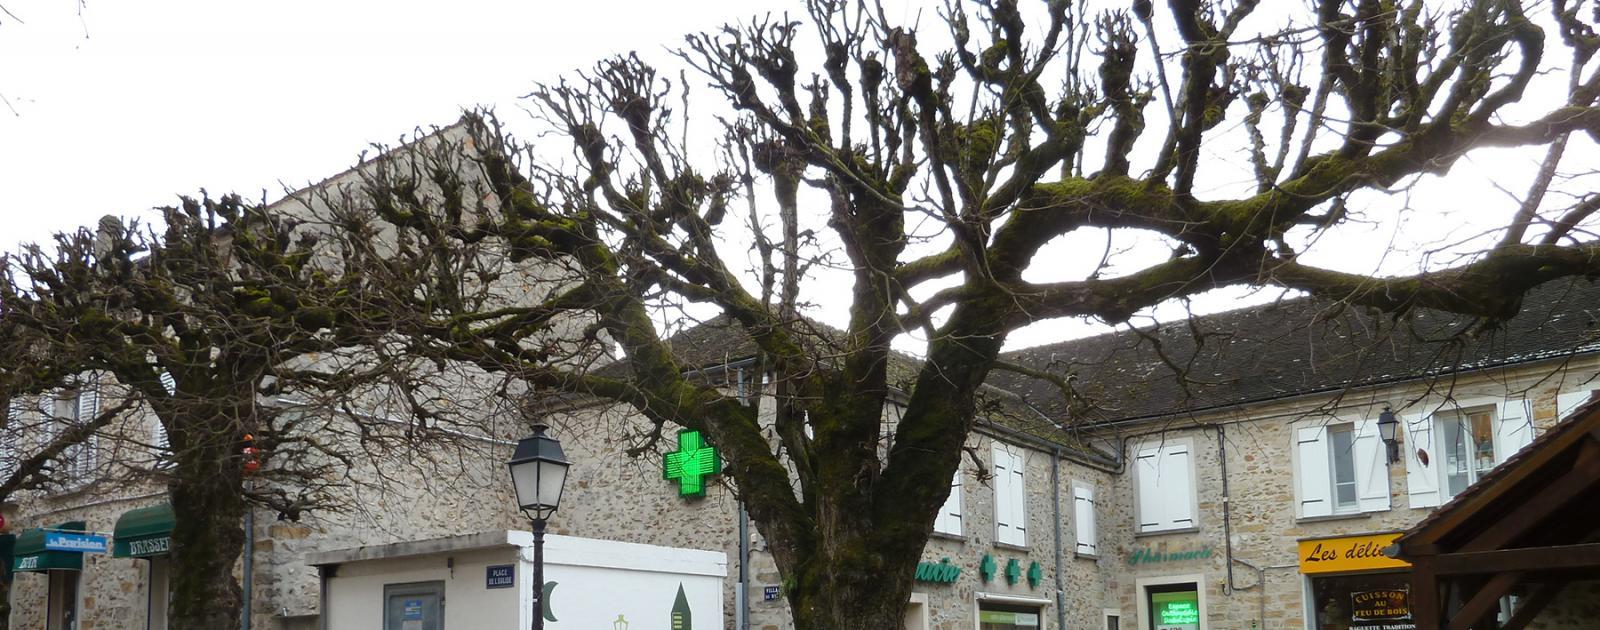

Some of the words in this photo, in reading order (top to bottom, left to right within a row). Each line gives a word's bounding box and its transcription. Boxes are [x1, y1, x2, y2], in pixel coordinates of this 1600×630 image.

[58, 537, 103, 549] Parisien
[1305, 543, 1337, 561] Les
[1355, 591, 1405, 603] CUISSON
